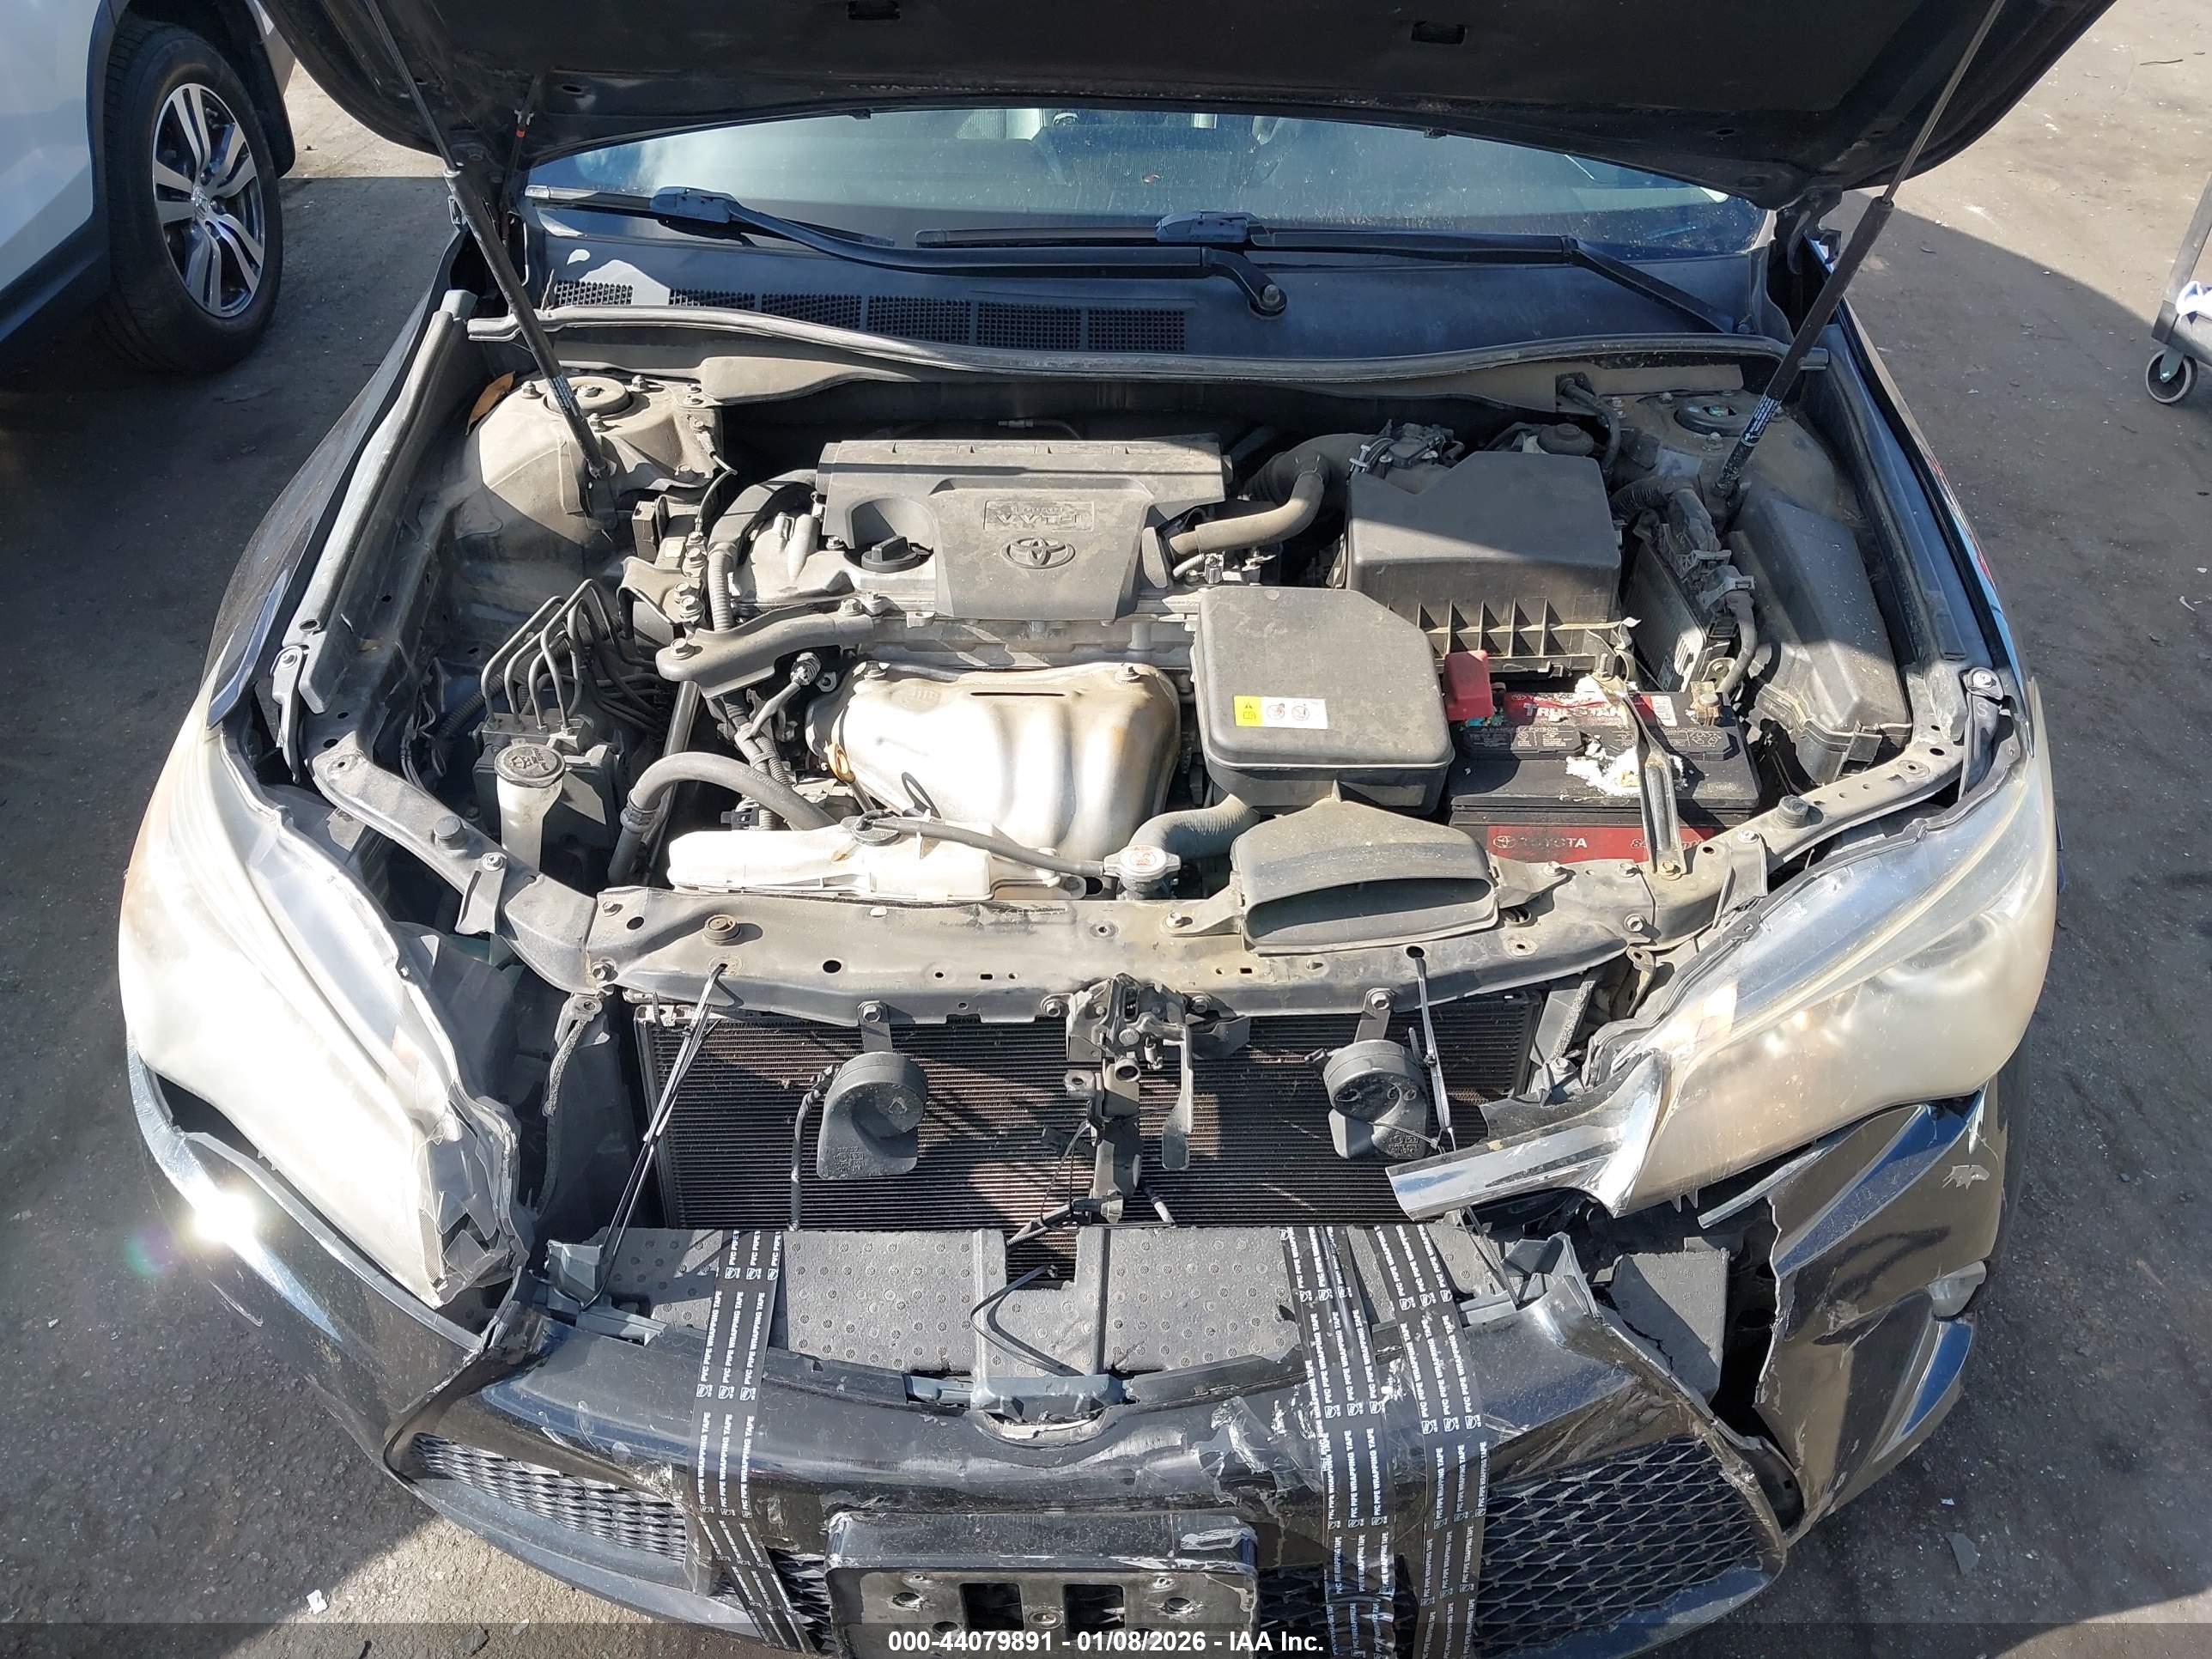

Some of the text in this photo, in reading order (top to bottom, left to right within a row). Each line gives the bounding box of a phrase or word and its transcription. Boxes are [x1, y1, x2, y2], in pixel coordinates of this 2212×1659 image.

[752, 1235, 761, 1250] PIPE
[773, 1235, 781, 1250] PIPE
[1395, 1283, 1405, 1297] PVC
[1415, 1278, 1425, 1292] PVC
[1436, 1273, 1446, 1288] PVC
[757, 1292, 765, 1310] TAPE
[1310, 1314, 1319, 1331] TAPE
[1352, 1310, 1362, 1327] TAPE
[701, 1291, 721, 1382] PVC PIPE WRAPPING TAPE
[722, 1291, 744, 1383] PVC PIPE WRAPPING TAPE
[750, 1311, 762, 1350] WRAPPING
[1314, 1332, 1327, 1370] WRAPPING
[1336, 1330, 1348, 1367] WRAPPING
[1357, 1328, 1370, 1364] WRAPPING
[747, 1352, 756, 1368] PIPE
[1401, 1323, 1429, 1418] PVC PIPE WRAPPING TAPE
[1421, 1319, 1450, 1415] PVC PIPE WRAPPING TAPE
[1443, 1316, 1472, 1413] PVC PIPE WRAPPING TAPE
[1321, 1370, 1329, 1388] PIPE
[1343, 1368, 1352, 1385] PIPE
[1365, 1366, 1374, 1382] PIPE
[702, 1412, 711, 1433] TAPE
[724, 1413, 732, 1436] TAPE
[745, 1415, 755, 1437] TAPE
[1344, 1431, 1353, 1451] TAPE
[698, 1435, 708, 1477] WRAPPING
[720, 1437, 729, 1480] WRAPPING
[741, 1439, 750, 1482] WRAPPING
[1347, 1452, 1358, 1492] WRAPPING
[1370, 1450, 1380, 1490] WRAPPING
